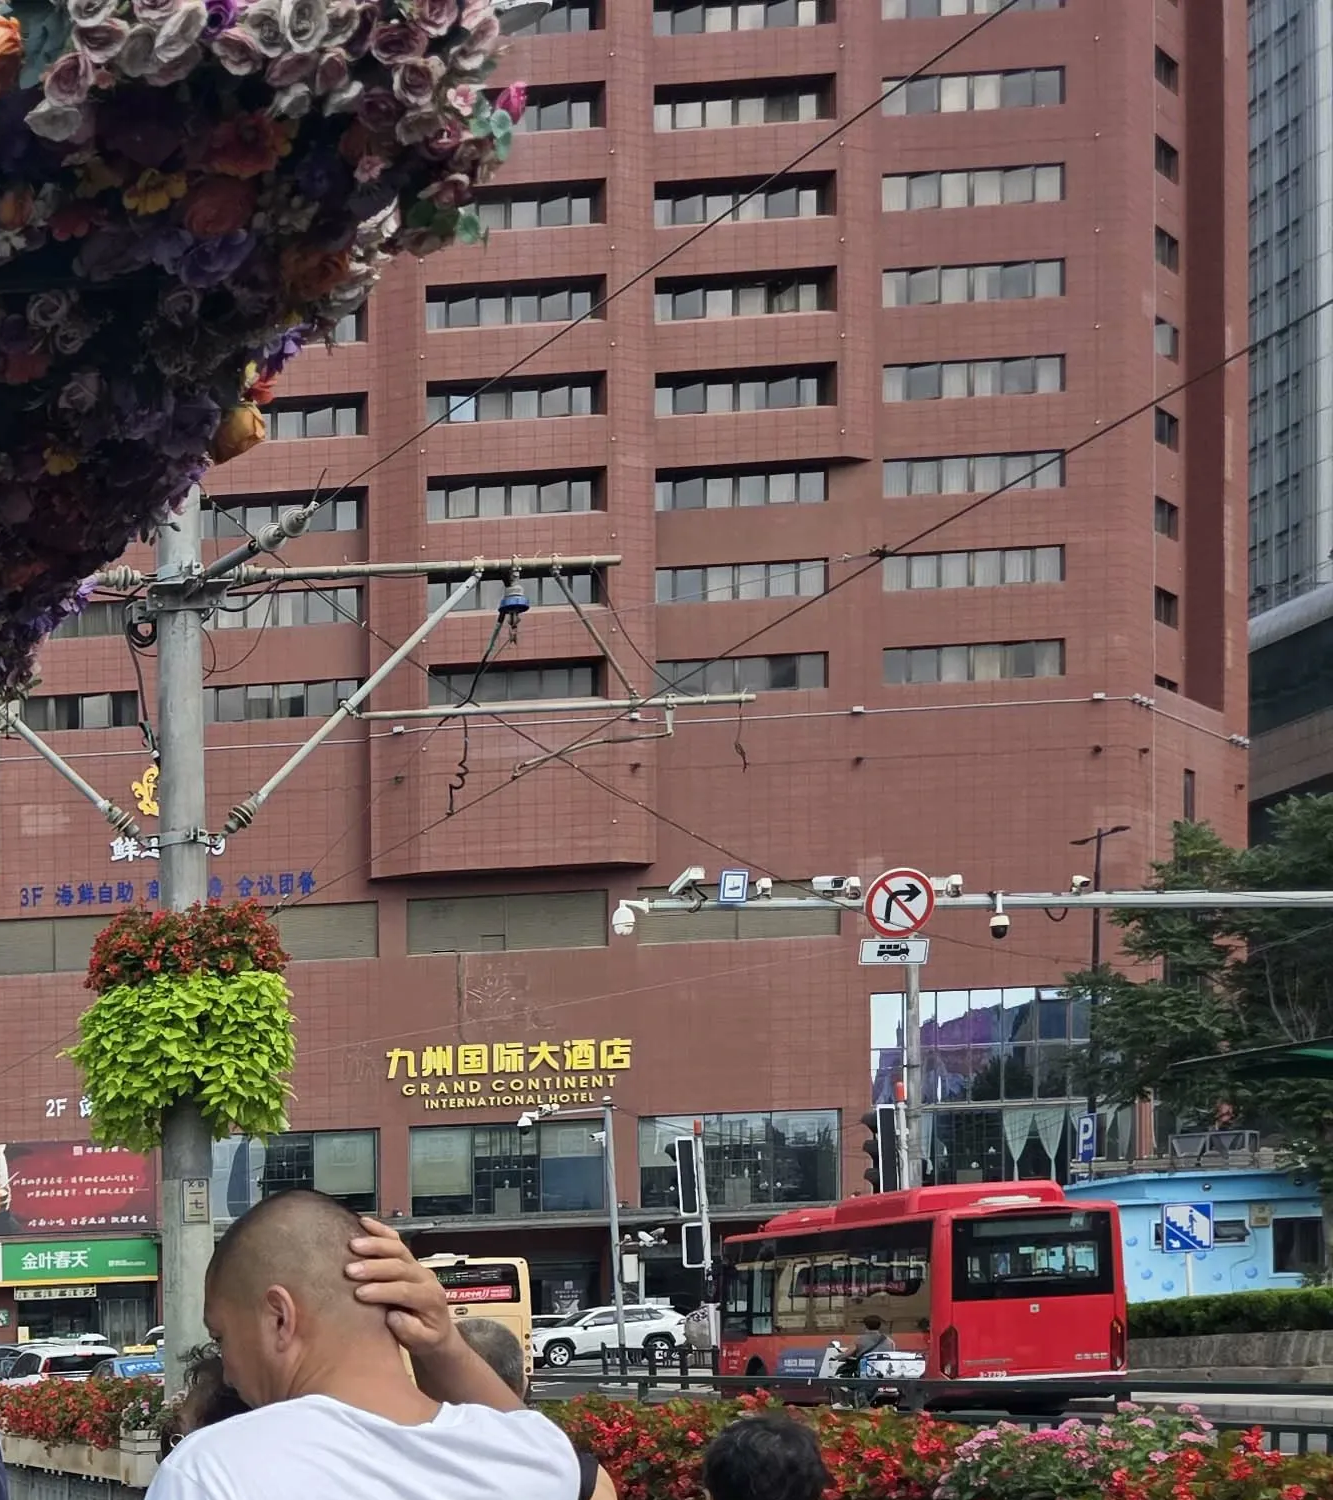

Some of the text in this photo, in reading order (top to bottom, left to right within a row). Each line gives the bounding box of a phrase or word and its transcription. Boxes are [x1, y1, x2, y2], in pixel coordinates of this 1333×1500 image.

[19, 886, 45, 908] 3F
[54, 880, 134, 907] 海鲜自助
[235, 869, 318, 898] 会议团餐
[386, 1038, 633, 1080] 九州国际大酒店
[402, 1074, 618, 1098] GRAND CONTINENT
[45, 1097, 68, 1118] 2F
[424, 1091, 596, 1110] INTERNATIONAL HOTEL
[1078, 1117, 1093, 1154] P
[21, 1250, 88, 1271] 金叶春天
